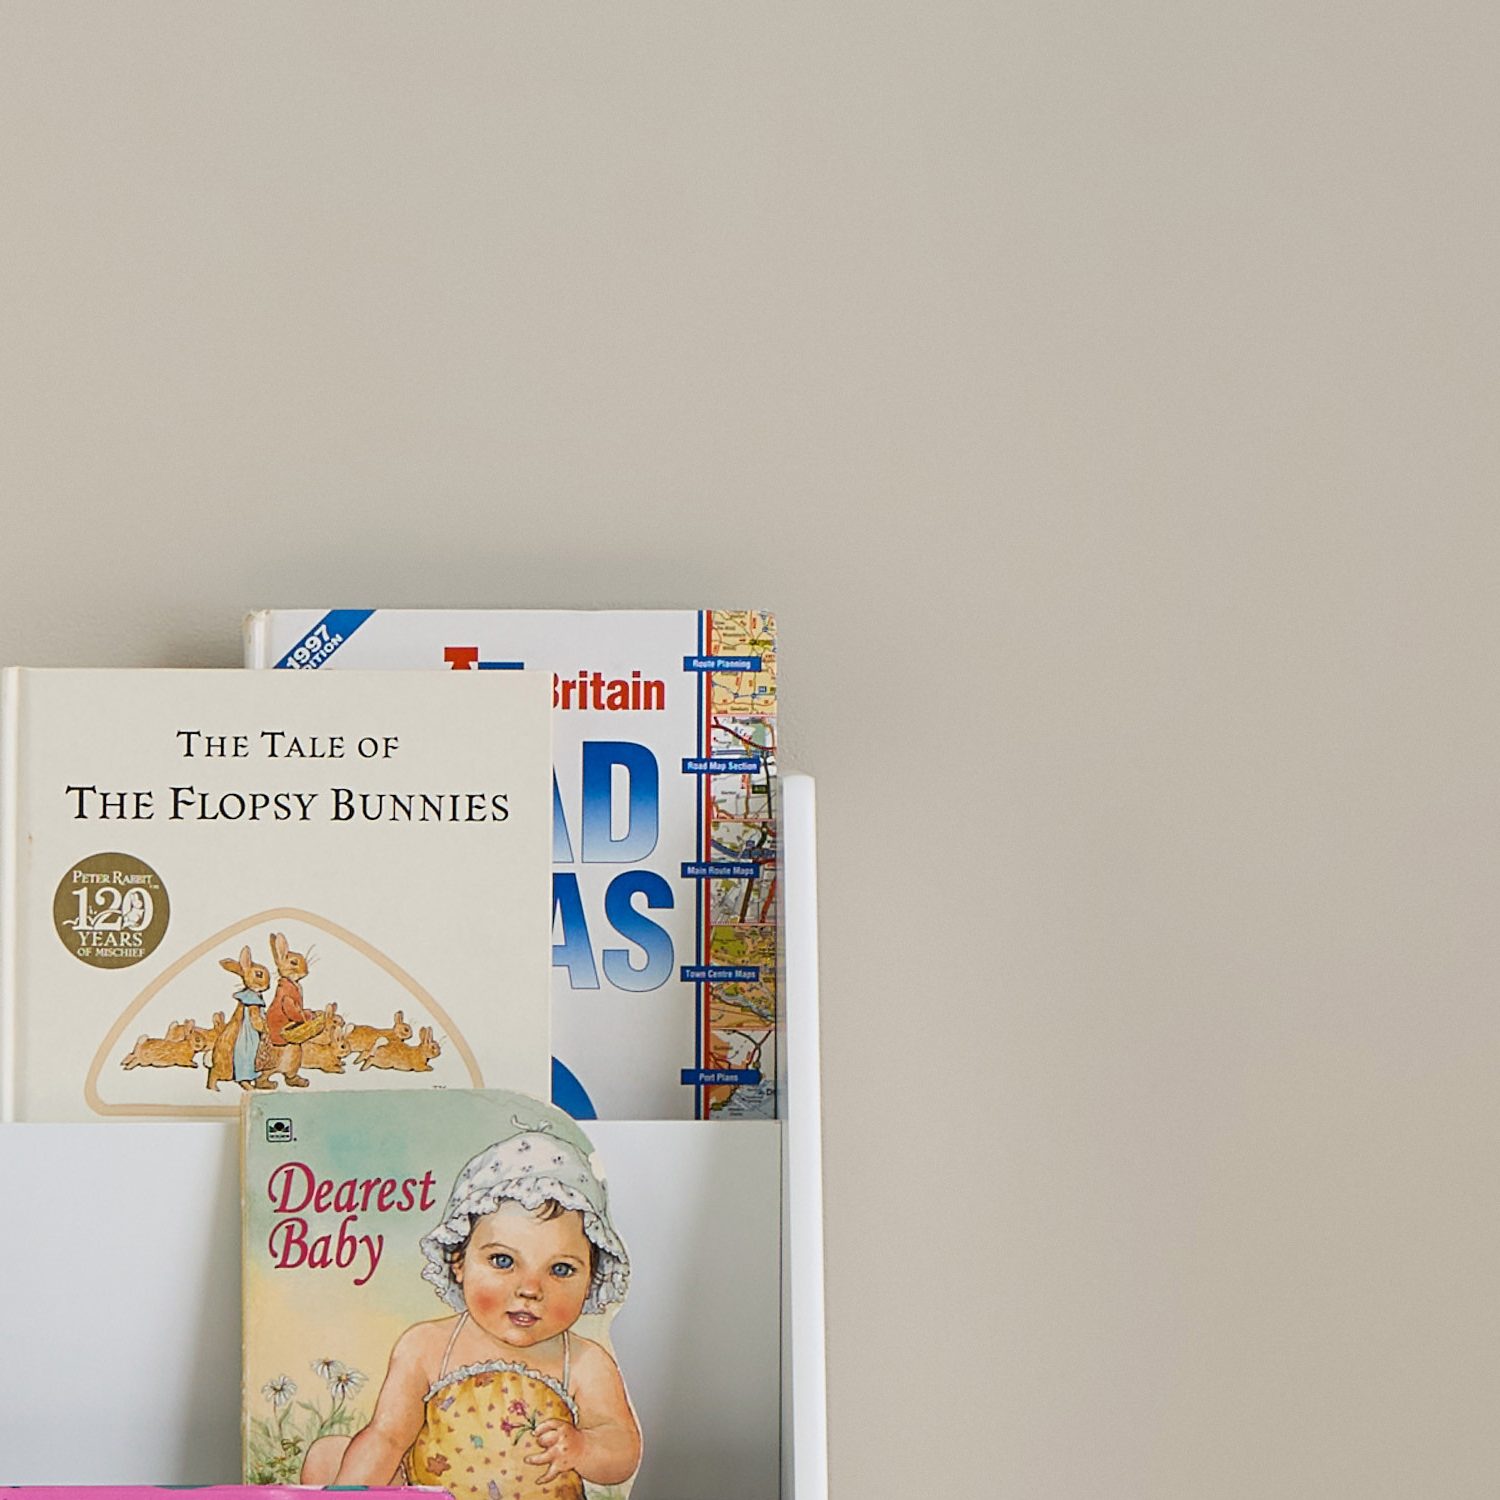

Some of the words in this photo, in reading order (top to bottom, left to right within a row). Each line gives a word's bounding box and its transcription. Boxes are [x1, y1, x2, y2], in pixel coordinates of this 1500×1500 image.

[286, 624, 330, 669] 1997
[692, 659, 715, 668] Route
[716, 659, 751, 670] Planning
[176, 730, 249, 757] THE
[357, 736, 399, 758] OF
[687, 761, 708, 770] Road
[709, 761, 727, 771] Map
[728, 761, 757, 770] Section
[65, 785, 154, 820] THE
[168, 786, 318, 821] FLOPSY
[330, 788, 509, 822] BUNNIES
[72, 870, 110, 884] PETER
[687, 866, 707, 875] Main
[708, 866, 731, 875] Route
[733, 866, 754, 876] Maps
[71, 886, 154, 931] 120
[78, 931, 143, 947] YEARS
[77, 948, 92, 957] OF
[95, 948, 145, 957] MISCHIEF
[685, 969, 706, 978] Town
[707, 969, 733, 978] Centre
[735, 969, 756, 979] Maps
[699, 1073, 715, 1082] Port
[716, 1073, 738, 1082] Plans
[267, 1162, 437, 1214] Dearest
[268, 1214, 384, 1286] Baby
